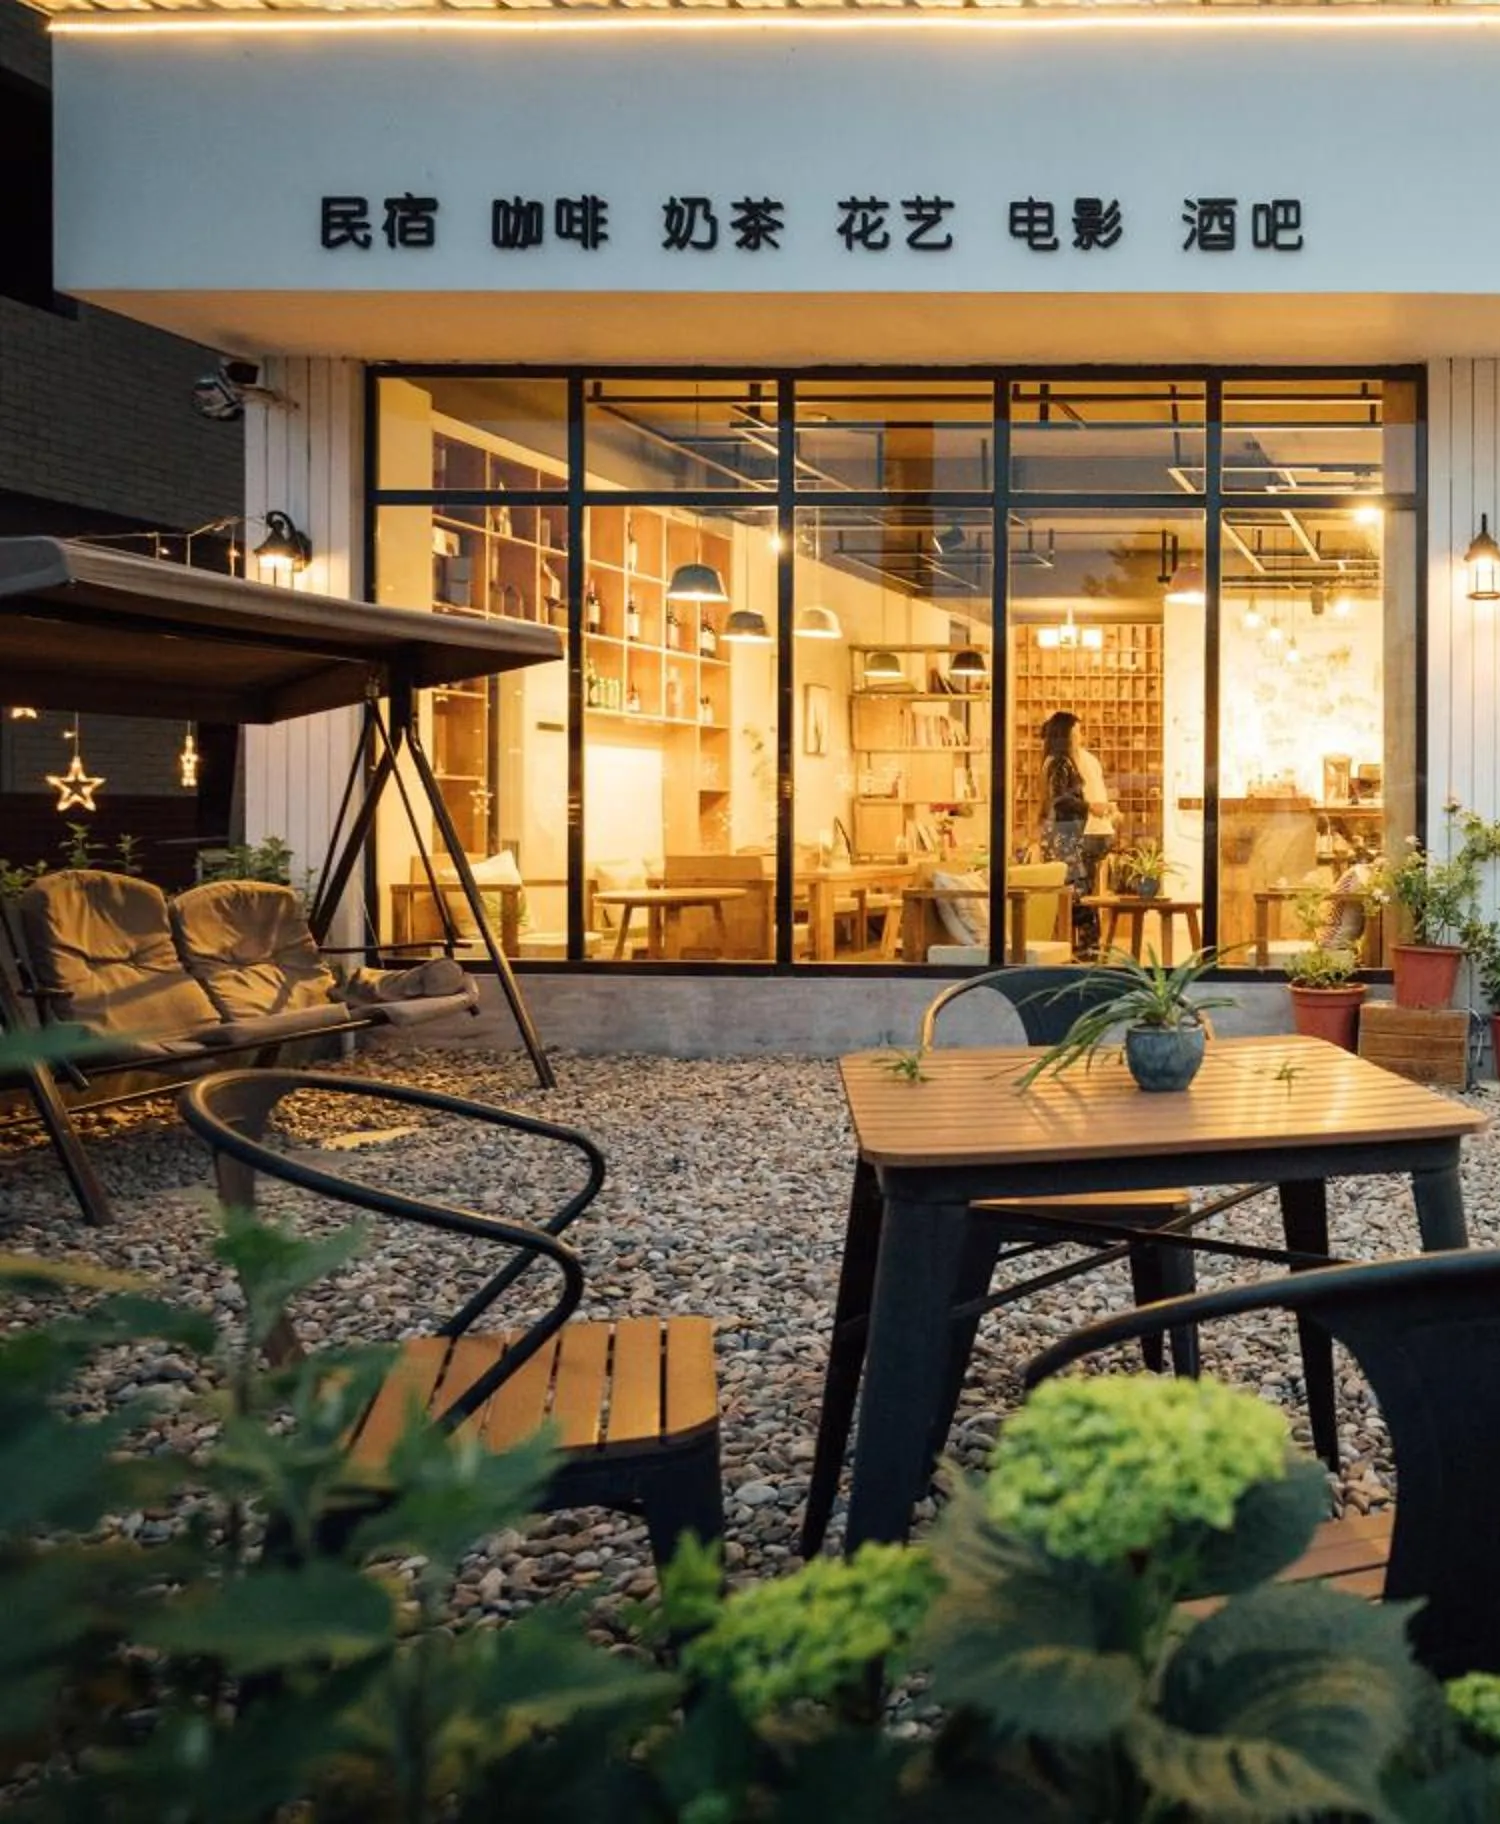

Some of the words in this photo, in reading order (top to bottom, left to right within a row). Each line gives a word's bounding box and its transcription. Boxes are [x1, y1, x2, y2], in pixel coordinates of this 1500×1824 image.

[320, 192, 439, 251] 民宿
[491, 195, 609, 251] 咖啡
[662, 196, 784, 252] 奶茶
[837, 196, 954, 251] 花艺
[1009, 197, 1123, 252] 电影
[1182, 198, 1303, 251] 酒吧
